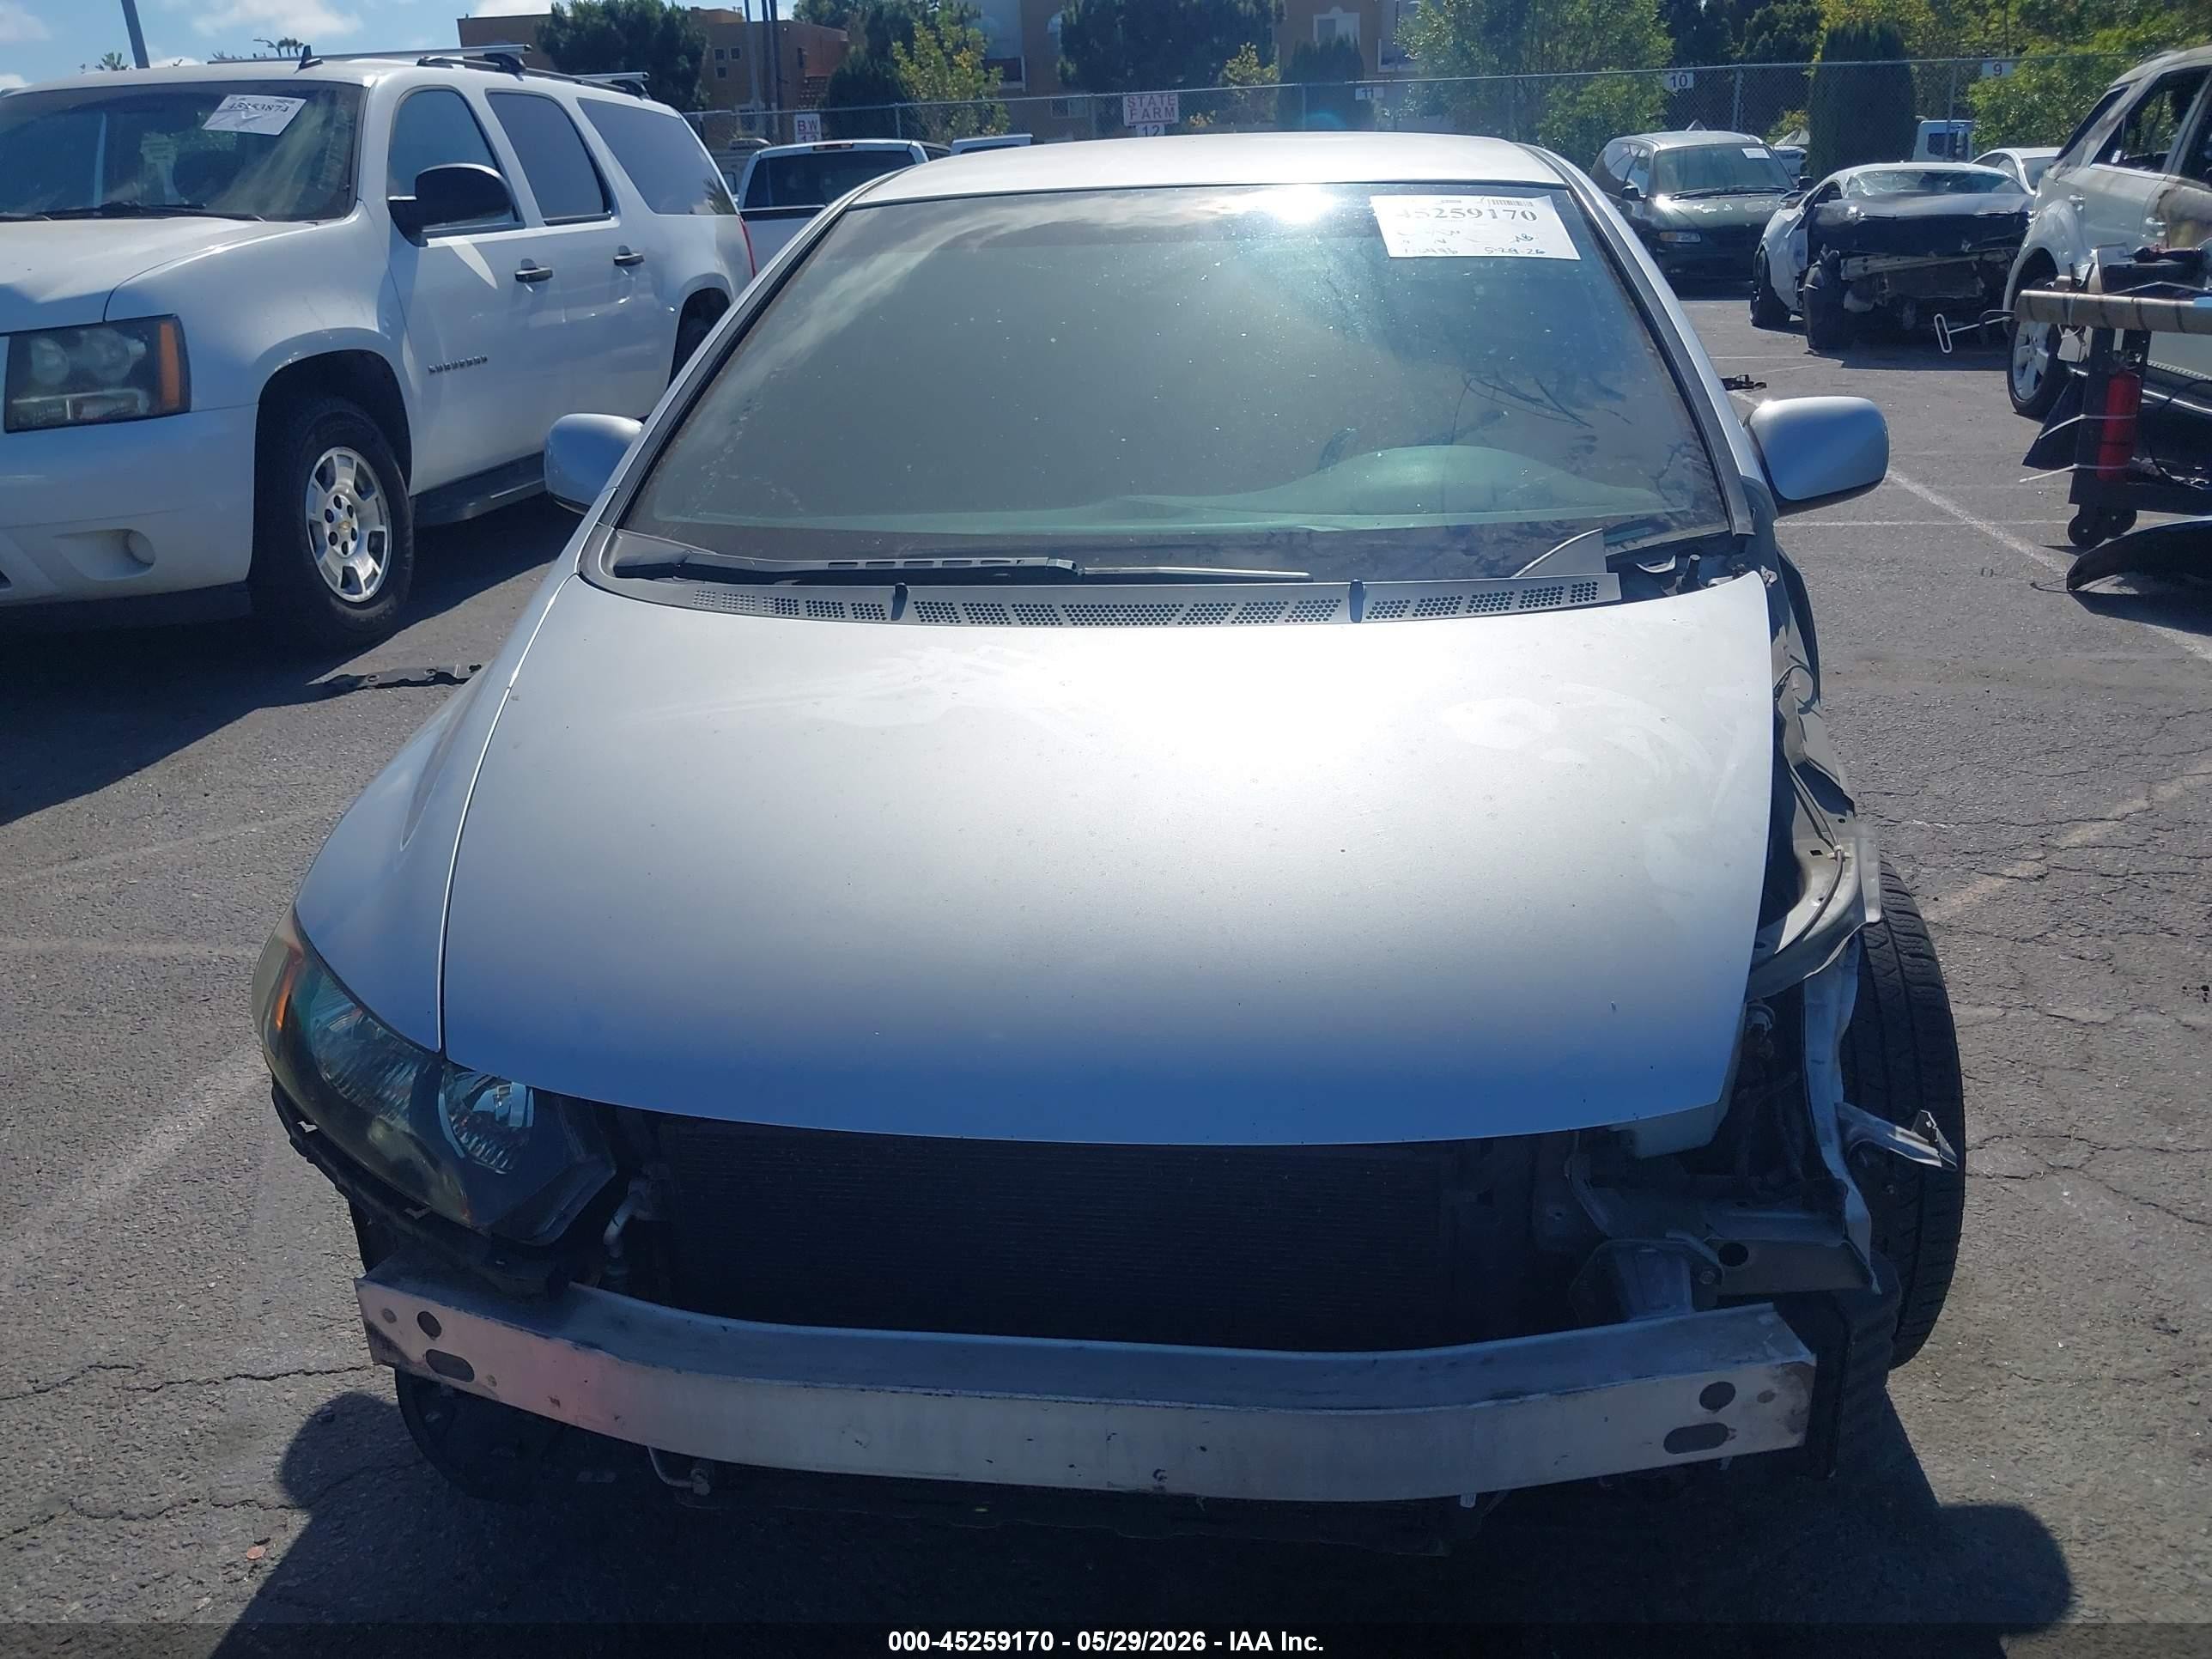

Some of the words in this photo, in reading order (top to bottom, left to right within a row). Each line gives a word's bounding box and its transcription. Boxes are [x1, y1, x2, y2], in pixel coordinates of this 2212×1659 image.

[1993, 64, 2002, 76] 9
[1669, 75, 1688, 88] 10
[1127, 95, 1176, 108] STATE
[1129, 106, 1176, 120] FARM
[797, 119, 818, 131] BW
[1142, 125, 1160, 137] 12
